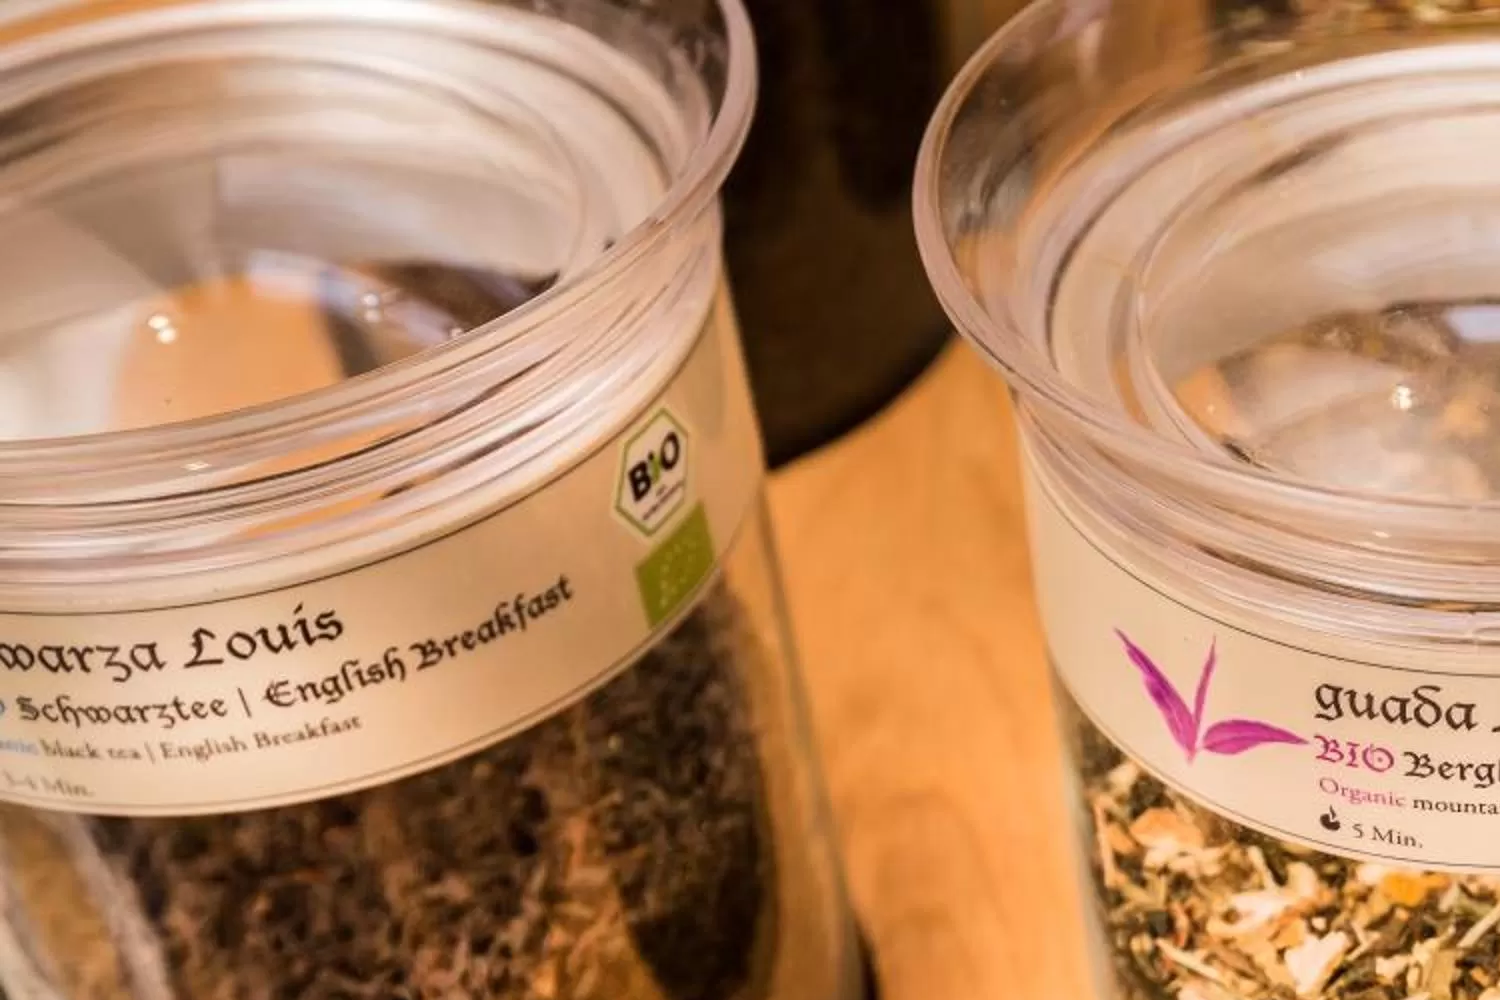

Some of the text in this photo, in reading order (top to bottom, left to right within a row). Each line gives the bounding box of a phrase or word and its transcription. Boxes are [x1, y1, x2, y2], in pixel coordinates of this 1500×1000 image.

[16, 693, 228, 729] Schwarztee
[263, 647, 407, 708] English
[408, 574, 574, 671] Breakfast
[184, 602, 344, 669] Louis
[160, 735, 249, 761] English
[253, 715, 363, 750] Breakfast
[1313, 734, 1395, 773] BIO
[1319, 777, 1406, 807] Organic
[1351, 823, 1424, 849] 5 Min.
